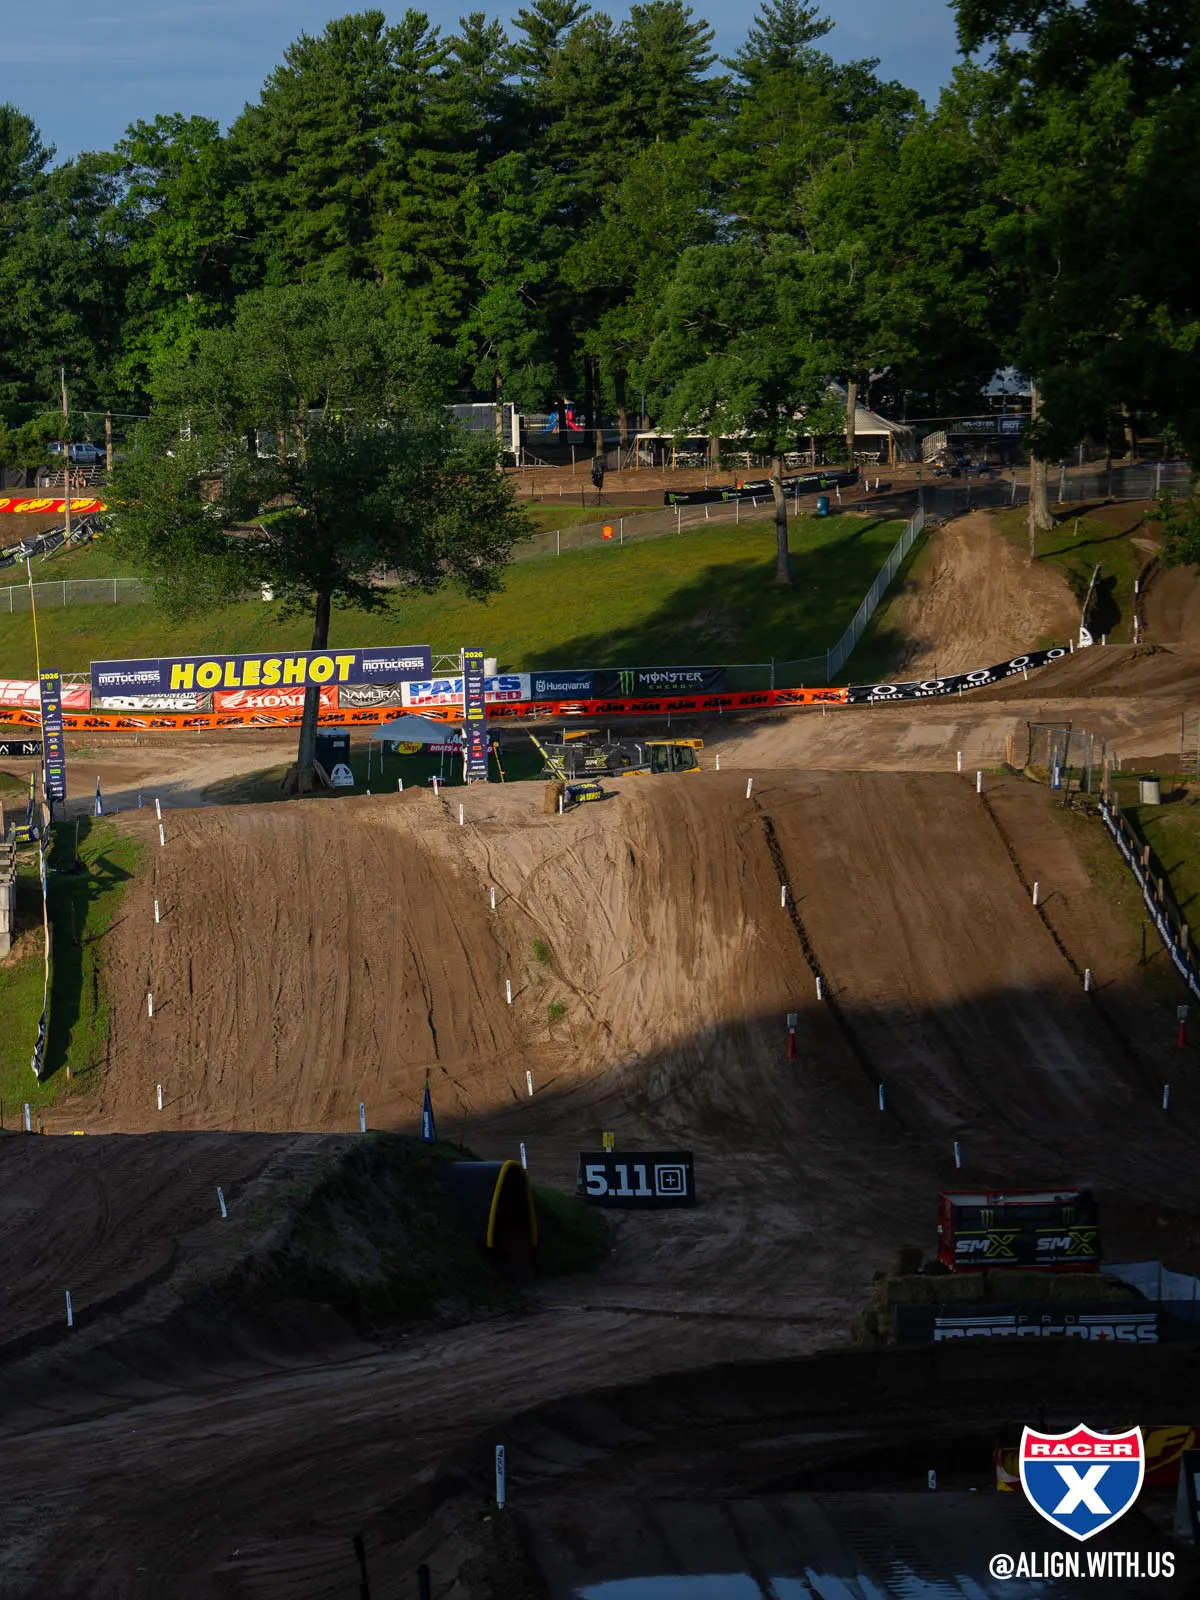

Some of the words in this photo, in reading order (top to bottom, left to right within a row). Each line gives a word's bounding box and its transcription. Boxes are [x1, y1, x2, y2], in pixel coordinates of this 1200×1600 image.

[362, 660, 424, 670] MOTOCROSS
[170, 653, 356, 691] HOLESHOT
[639, 672, 703, 683] MONSTER
[99, 673, 160, 684] MOTOCROSS
[962, 676, 997, 689] OAKLEY
[547, 681, 590, 691] Husqvarna
[340, 689, 399, 700] NAMURA
[915, 687, 951, 697] OAKLEY
[246, 694, 331, 708] HONA
[667, 700, 696, 710] KTM
[704, 698, 732, 707] KTM
[740, 695, 768, 704] KTM
[490, 705, 518, 717] KTM
[596, 703, 624, 712] KTM
[632, 702, 660, 711] KTM
[352, 713, 378, 721] KTM
[585, 1164, 653, 1197] 5.11
[955, 1233, 1016, 1258] SMX
[1036, 1231, 1097, 1256] SMX
